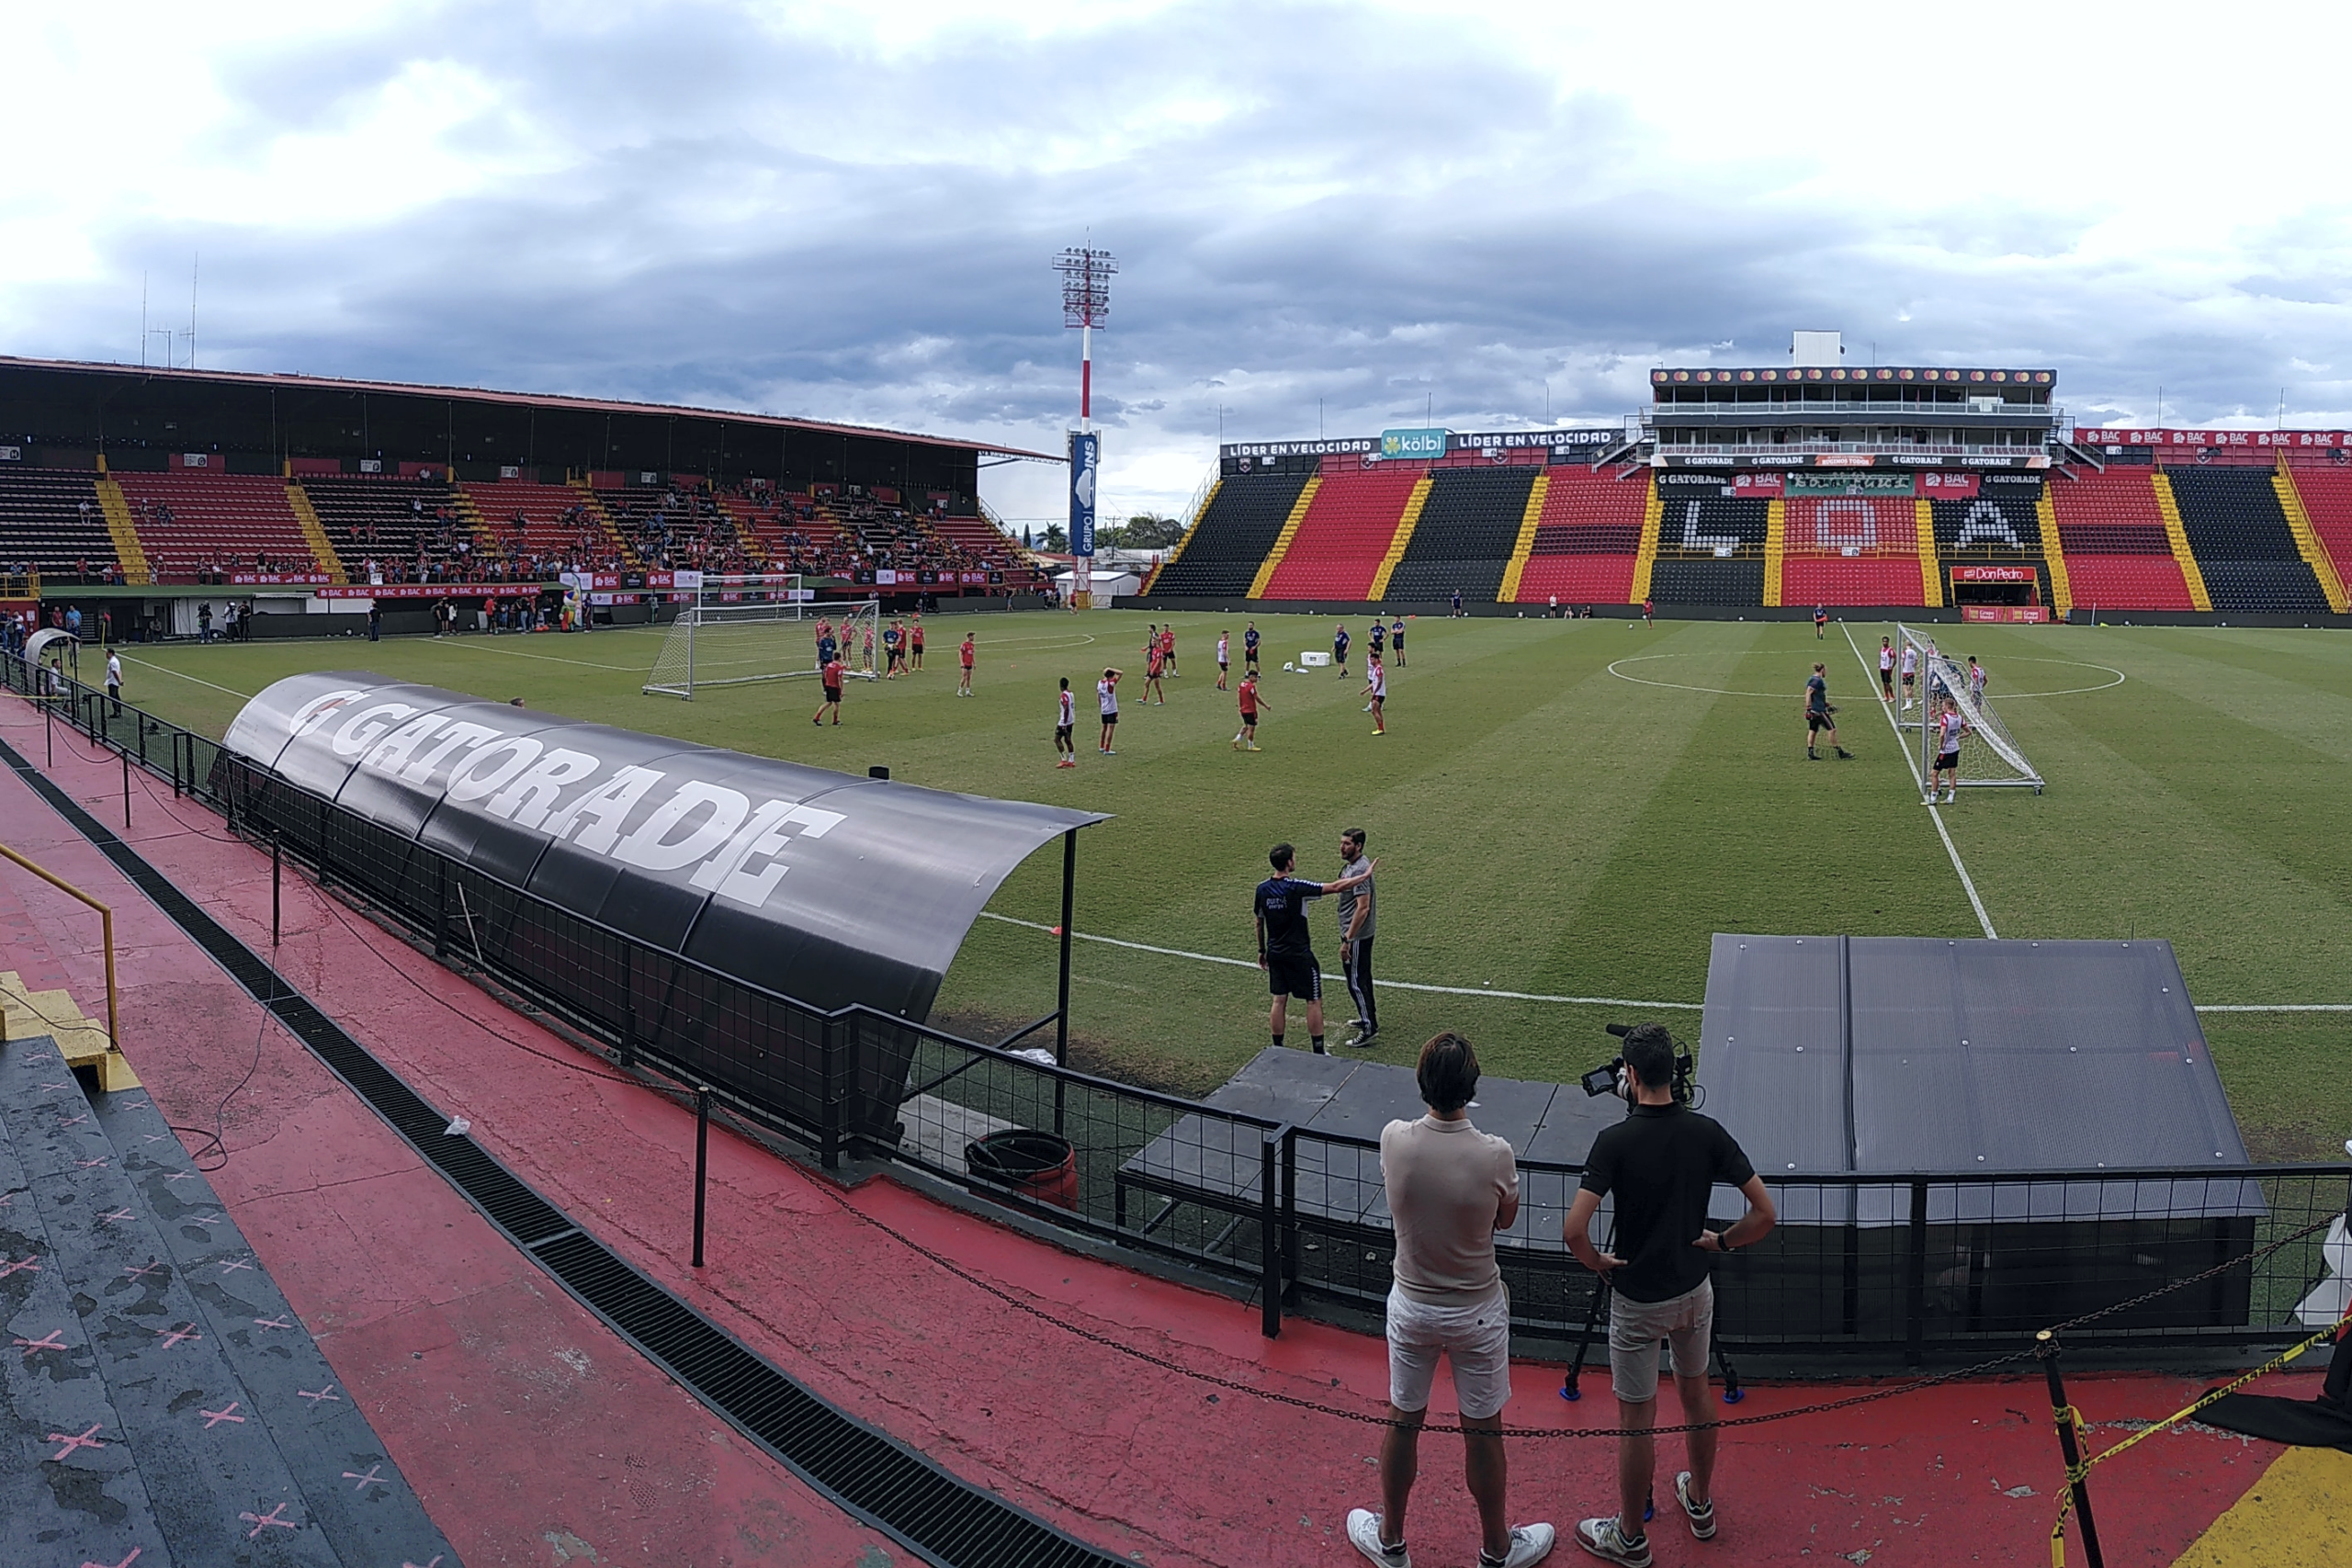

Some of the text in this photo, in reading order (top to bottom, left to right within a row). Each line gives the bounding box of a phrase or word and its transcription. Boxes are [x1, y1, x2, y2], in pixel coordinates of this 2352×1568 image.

[1460, 432, 1611, 446] LÍDER EN VELOCIDAD
[2102, 431, 2120, 440] BAC
[2144, 432, 2163, 441] BAC
[2188, 433, 2206, 442] BAC
[2230, 433, 2248, 442] BAC
[2272, 434, 2290, 443] BAC
[2314, 434, 2333, 443] BAC
[1401, 434, 1442, 452] kölbi
[1230, 441, 1371, 456] LÍDER EN VELOCIDAD
[1084, 441, 1094, 468] INS
[1668, 475, 1726, 484] GATORADE
[1755, 473, 1781, 482] BAC
[1944, 474, 1969, 483] BAC
[1082, 516, 1093, 552] GRUPO
[288, 690, 847, 908] G GATORADE
